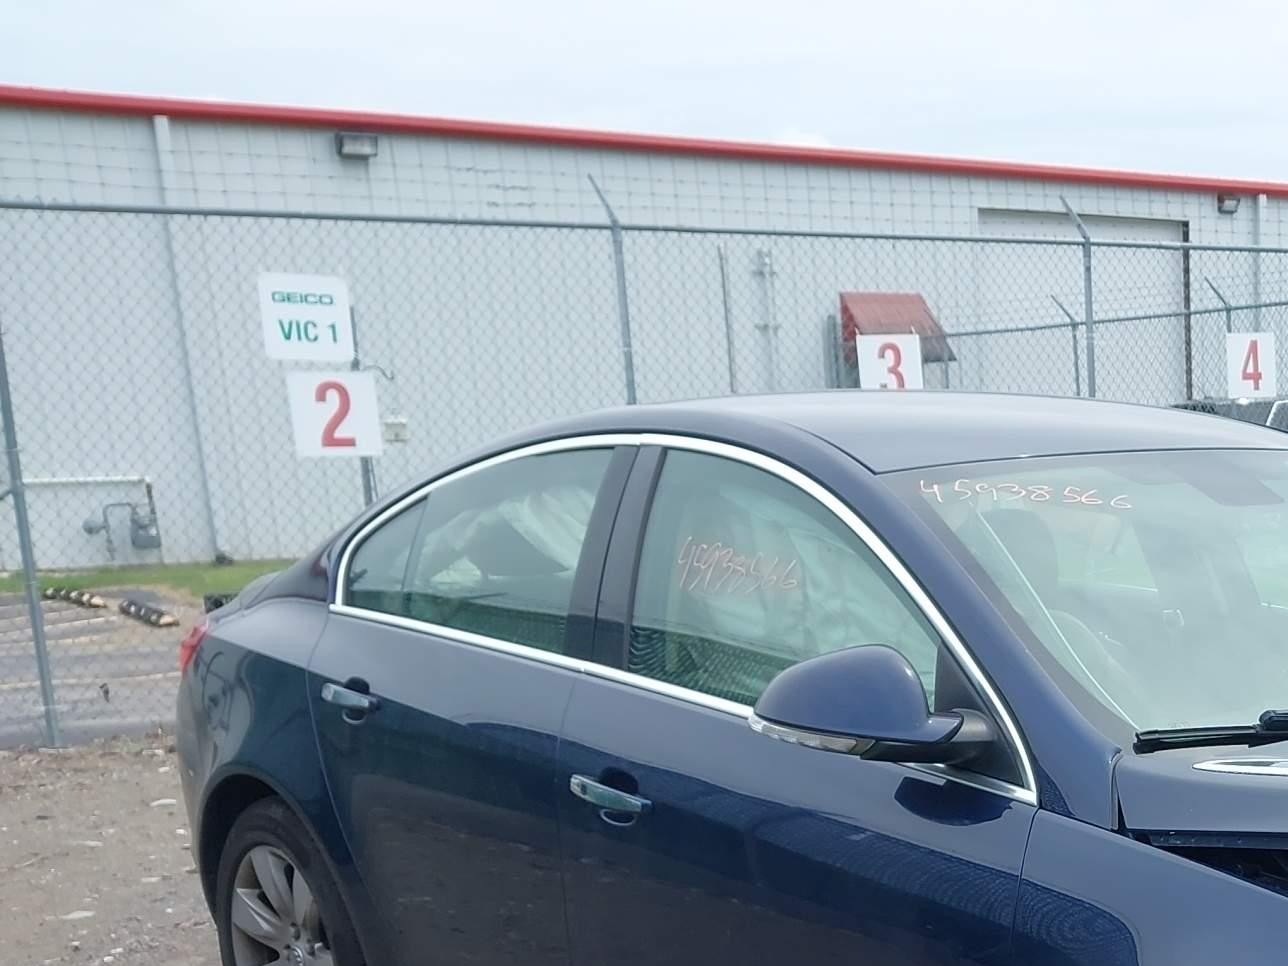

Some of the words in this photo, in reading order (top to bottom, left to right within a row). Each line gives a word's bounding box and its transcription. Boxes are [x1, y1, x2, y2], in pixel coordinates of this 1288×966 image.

[271, 291, 334, 305] GEICO
[278, 320, 318, 342] VIC
[327, 322, 338, 343] 1
[878, 342, 905, 390] 3
[1242, 339, 1262, 391] 4
[315, 381, 357, 447] 2
